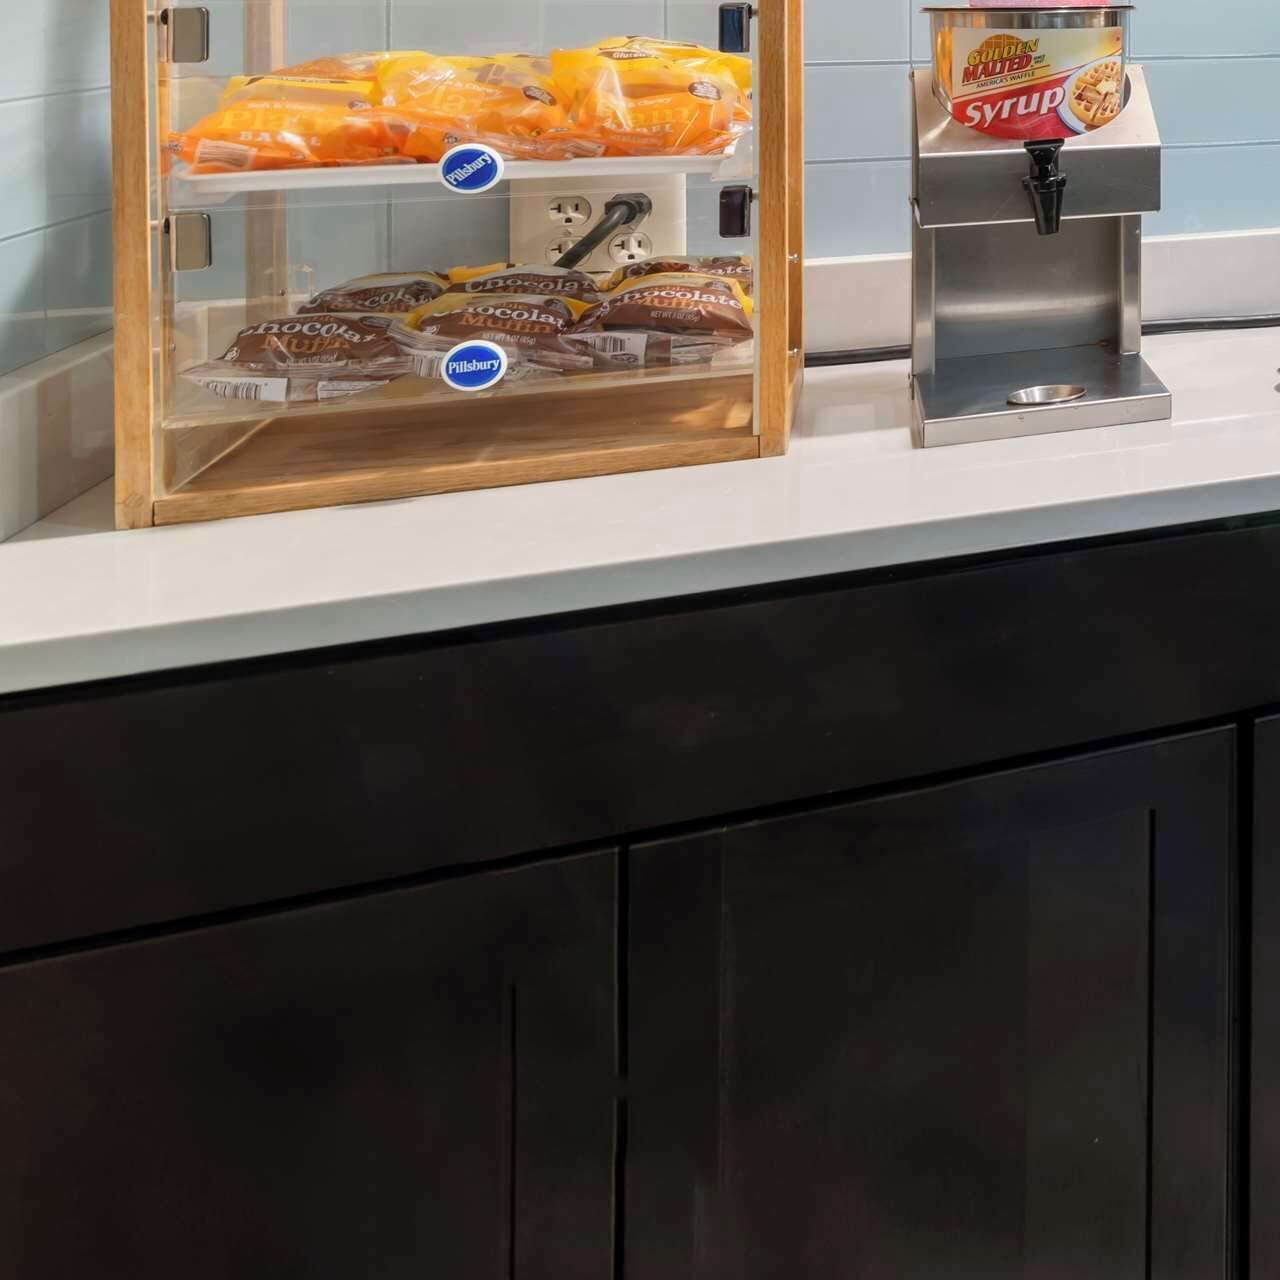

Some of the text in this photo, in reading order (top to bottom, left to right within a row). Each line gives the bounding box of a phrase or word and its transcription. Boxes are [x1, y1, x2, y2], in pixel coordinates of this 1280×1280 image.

[967, 38, 1040, 66] GOLDEN
[962, 53, 1033, 84] MALTED
[1009, 71, 1035, 81] WAFFLE
[964, 86, 1065, 128] Syrup
[445, 153, 492, 185] Pillsbury
[457, 312, 549, 334] Muffin
[448, 359, 500, 374] Pillsbury
